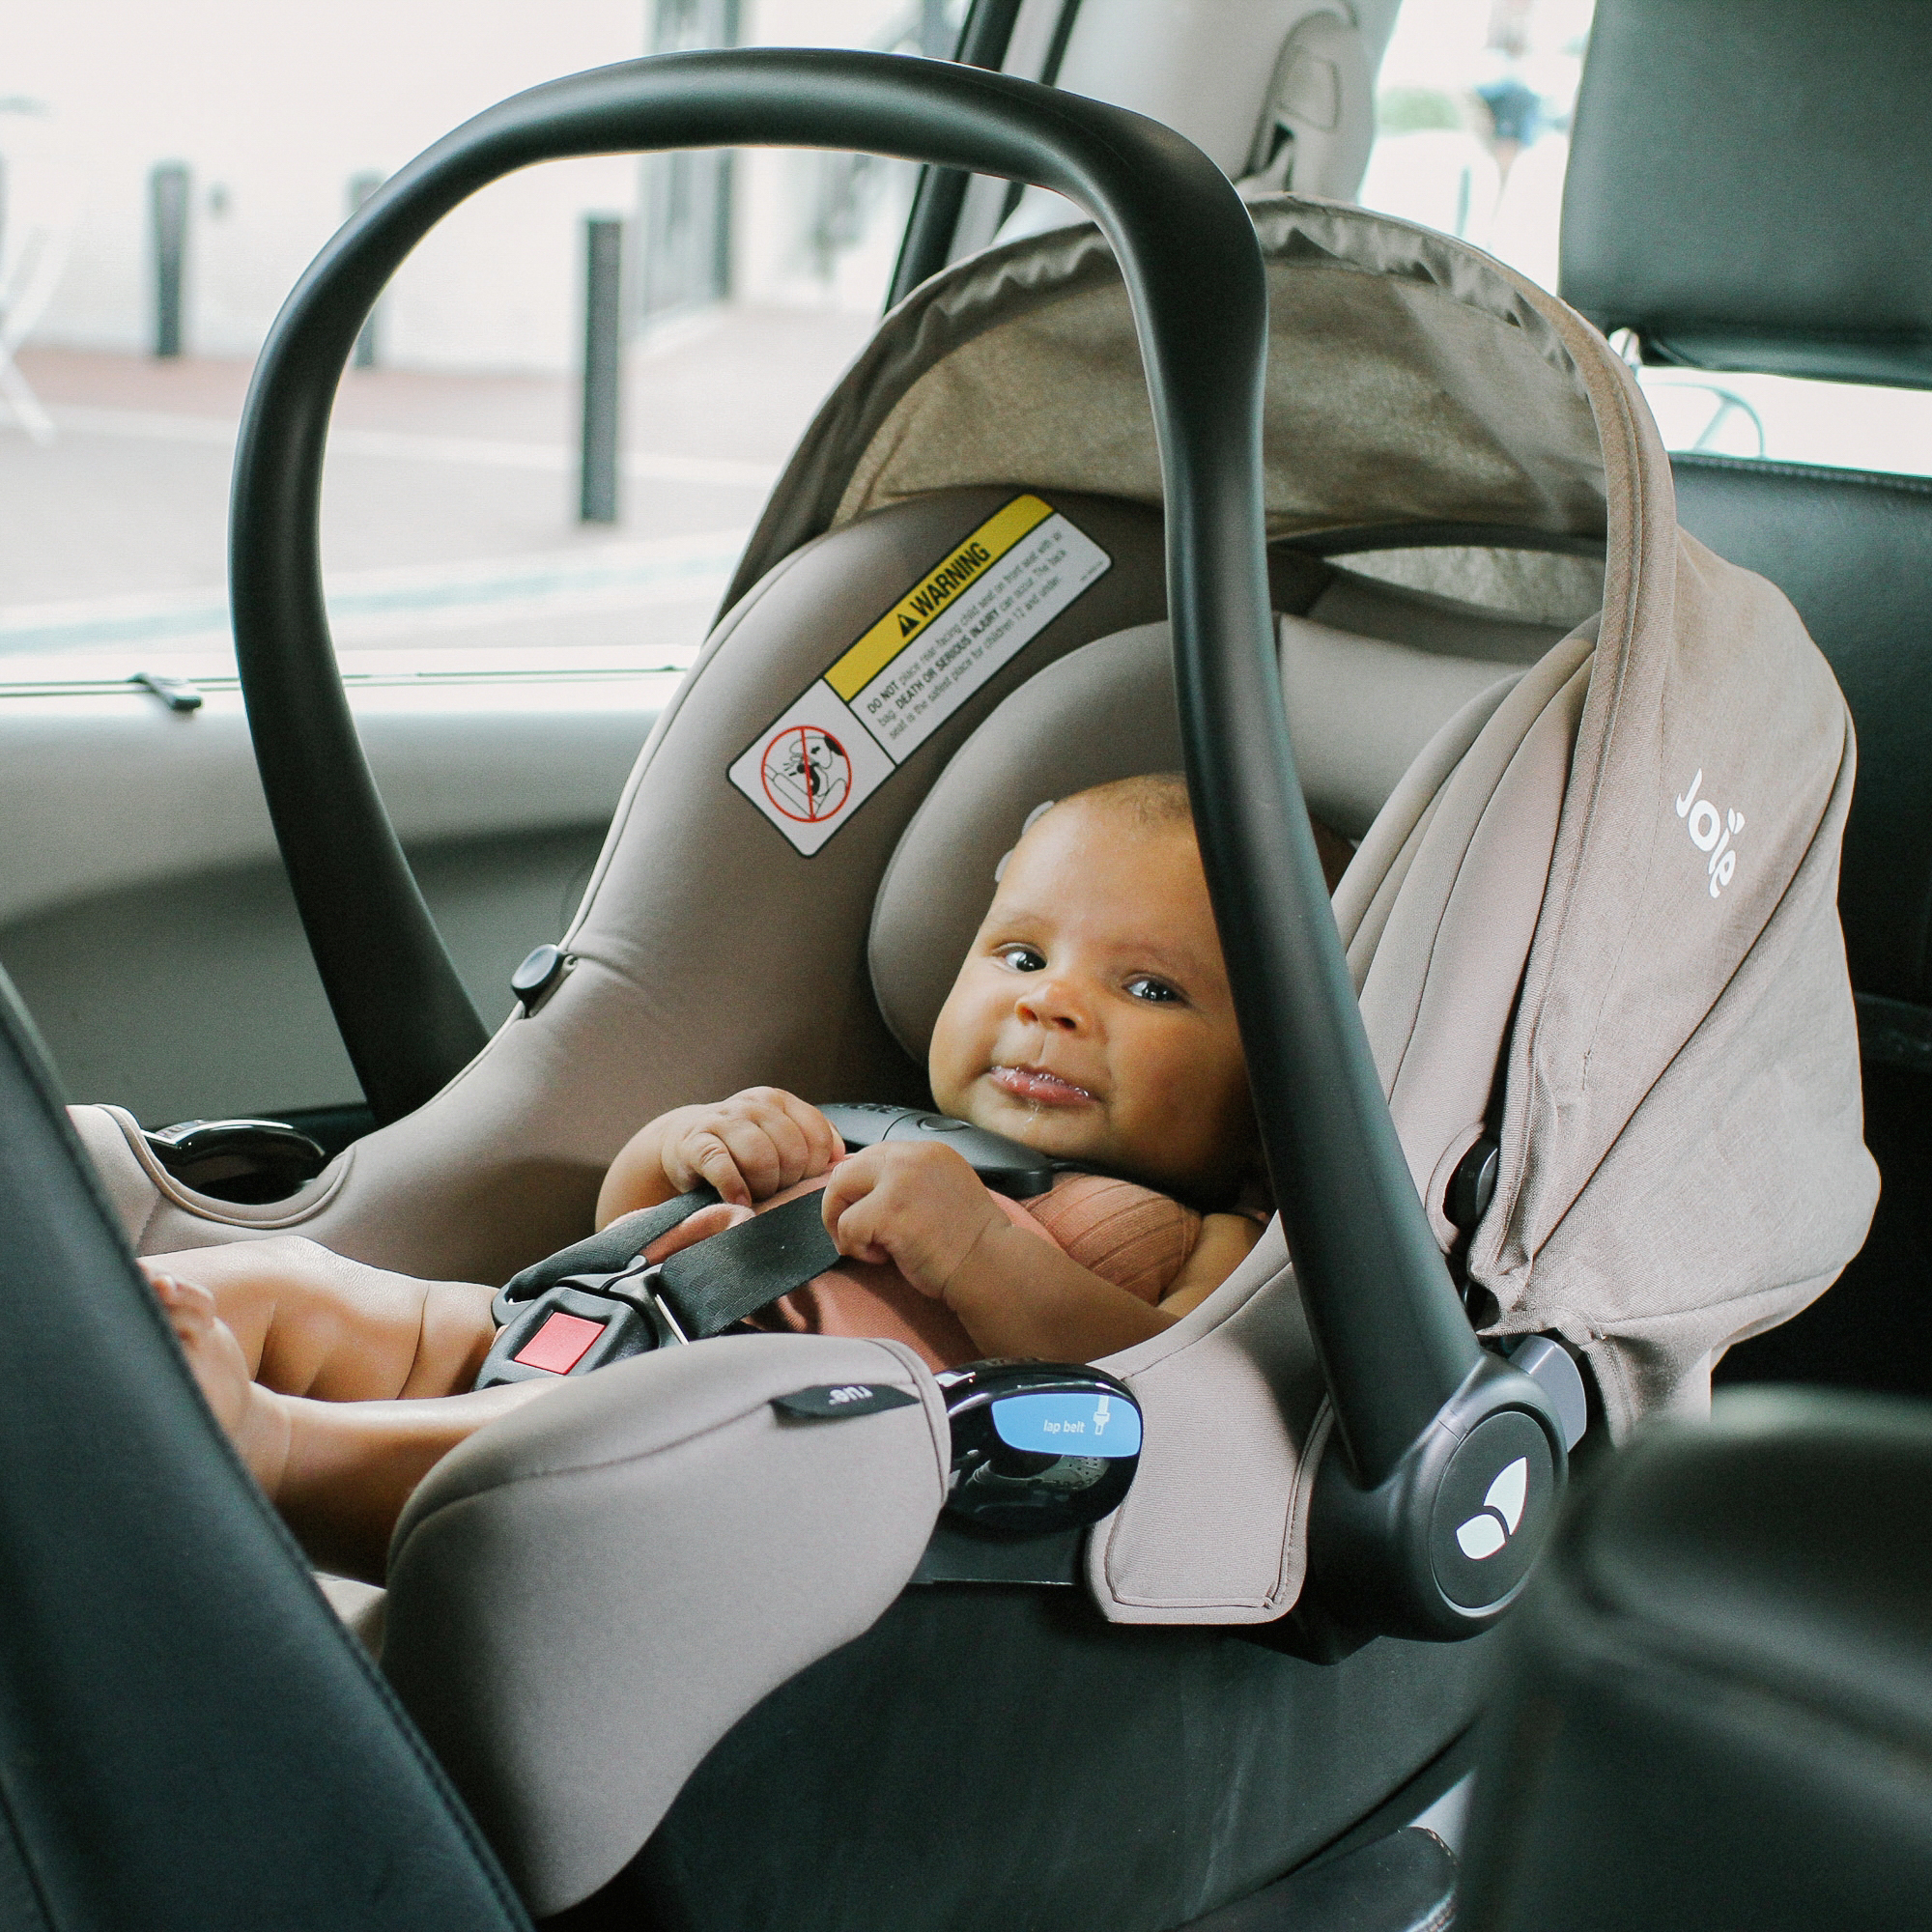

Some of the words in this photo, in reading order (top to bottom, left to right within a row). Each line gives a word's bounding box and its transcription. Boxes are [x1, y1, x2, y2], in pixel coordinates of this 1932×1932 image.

[910, 542, 991, 617] WARNING
[894, 678, 925, 709] DEATH
[920, 666, 938, 684] OR
[933, 634, 973, 671] SERIOUS
[968, 607, 1001, 639] INJURY
[866, 696, 883, 713] DO
[878, 679, 899, 700] NOT
[1676, 767, 1746, 898] Joie
[1043, 1419, 1062, 1435] lap
[1063, 1419, 1086, 1434] belt
